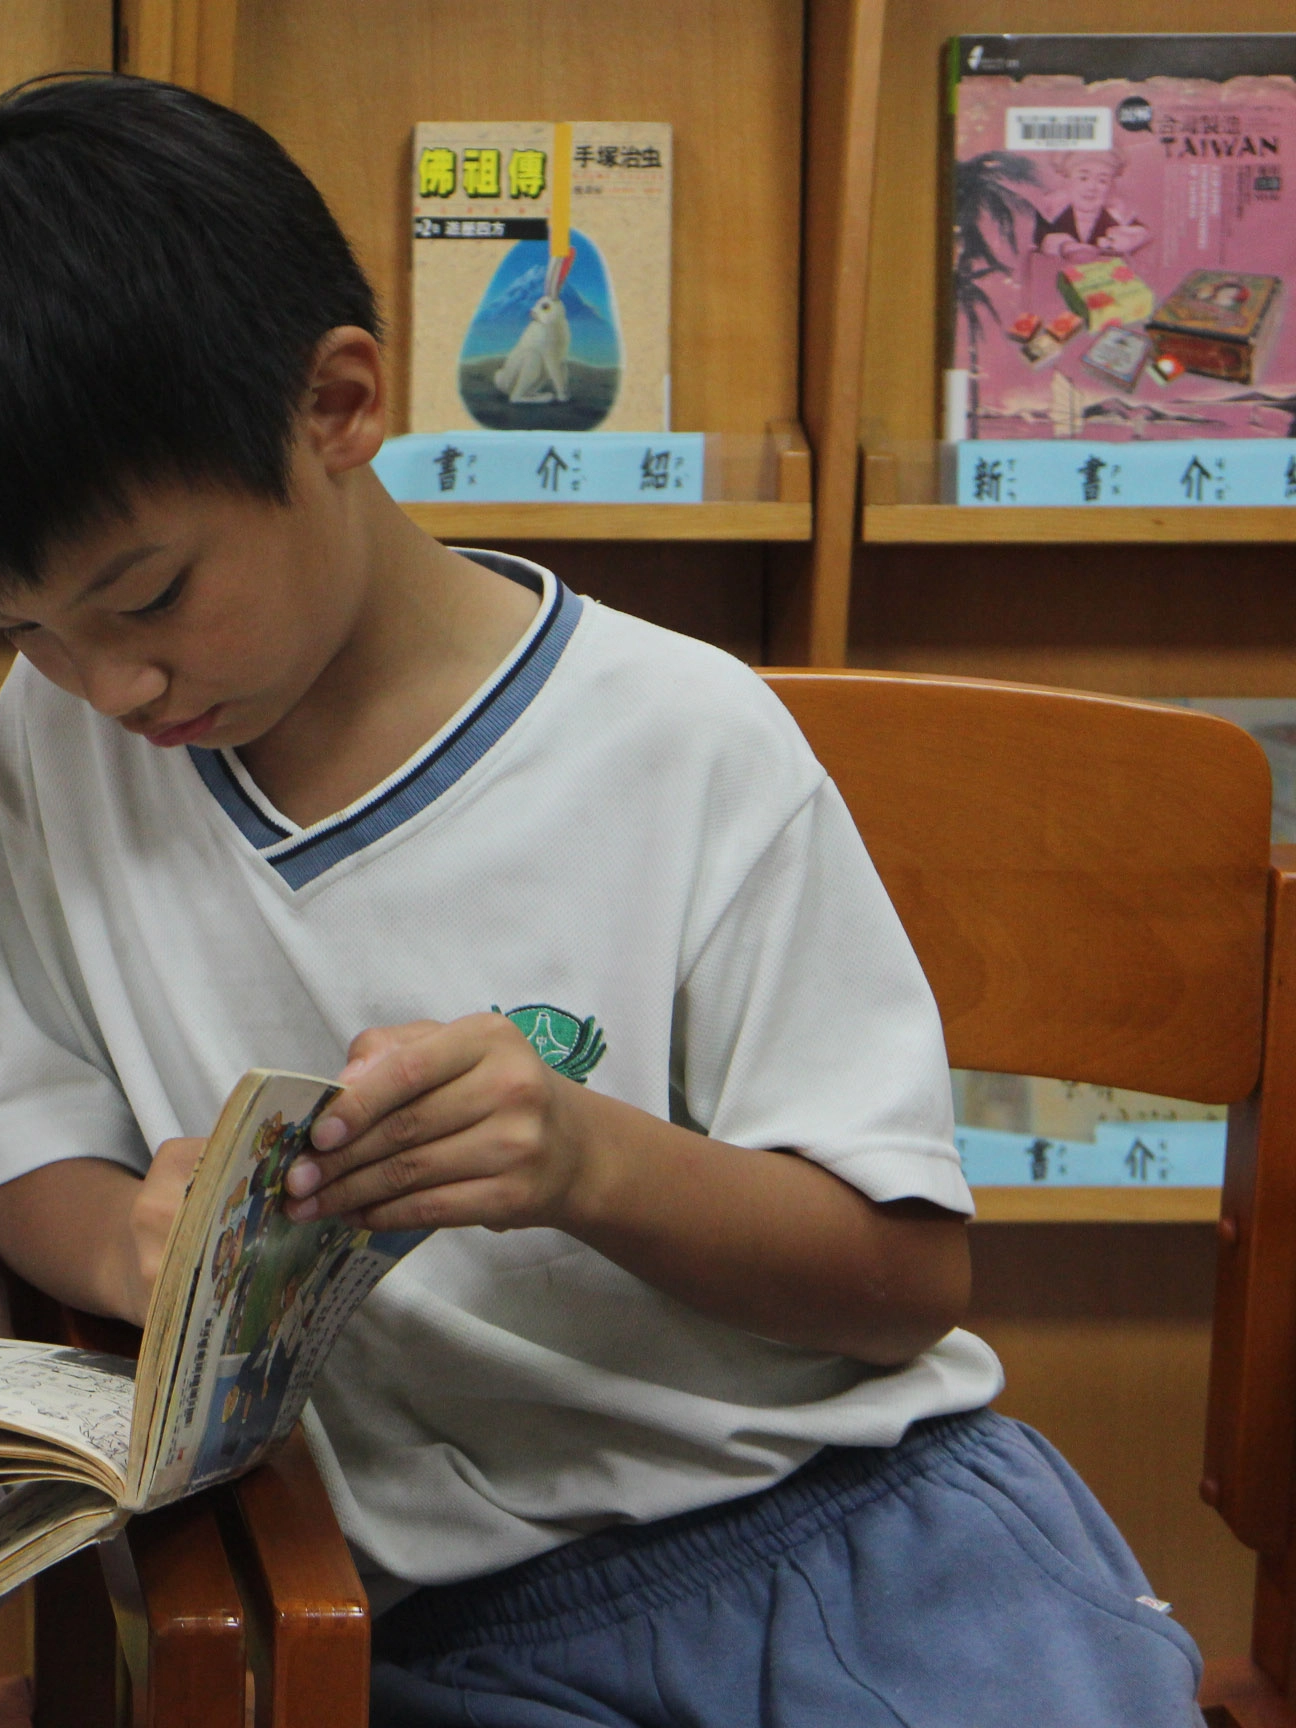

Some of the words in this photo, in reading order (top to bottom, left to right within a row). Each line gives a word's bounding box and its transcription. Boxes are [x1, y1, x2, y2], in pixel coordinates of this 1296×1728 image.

[1159, 136, 1280, 158] TAIWAN
[418, 147, 547, 199] 佛祖傳
